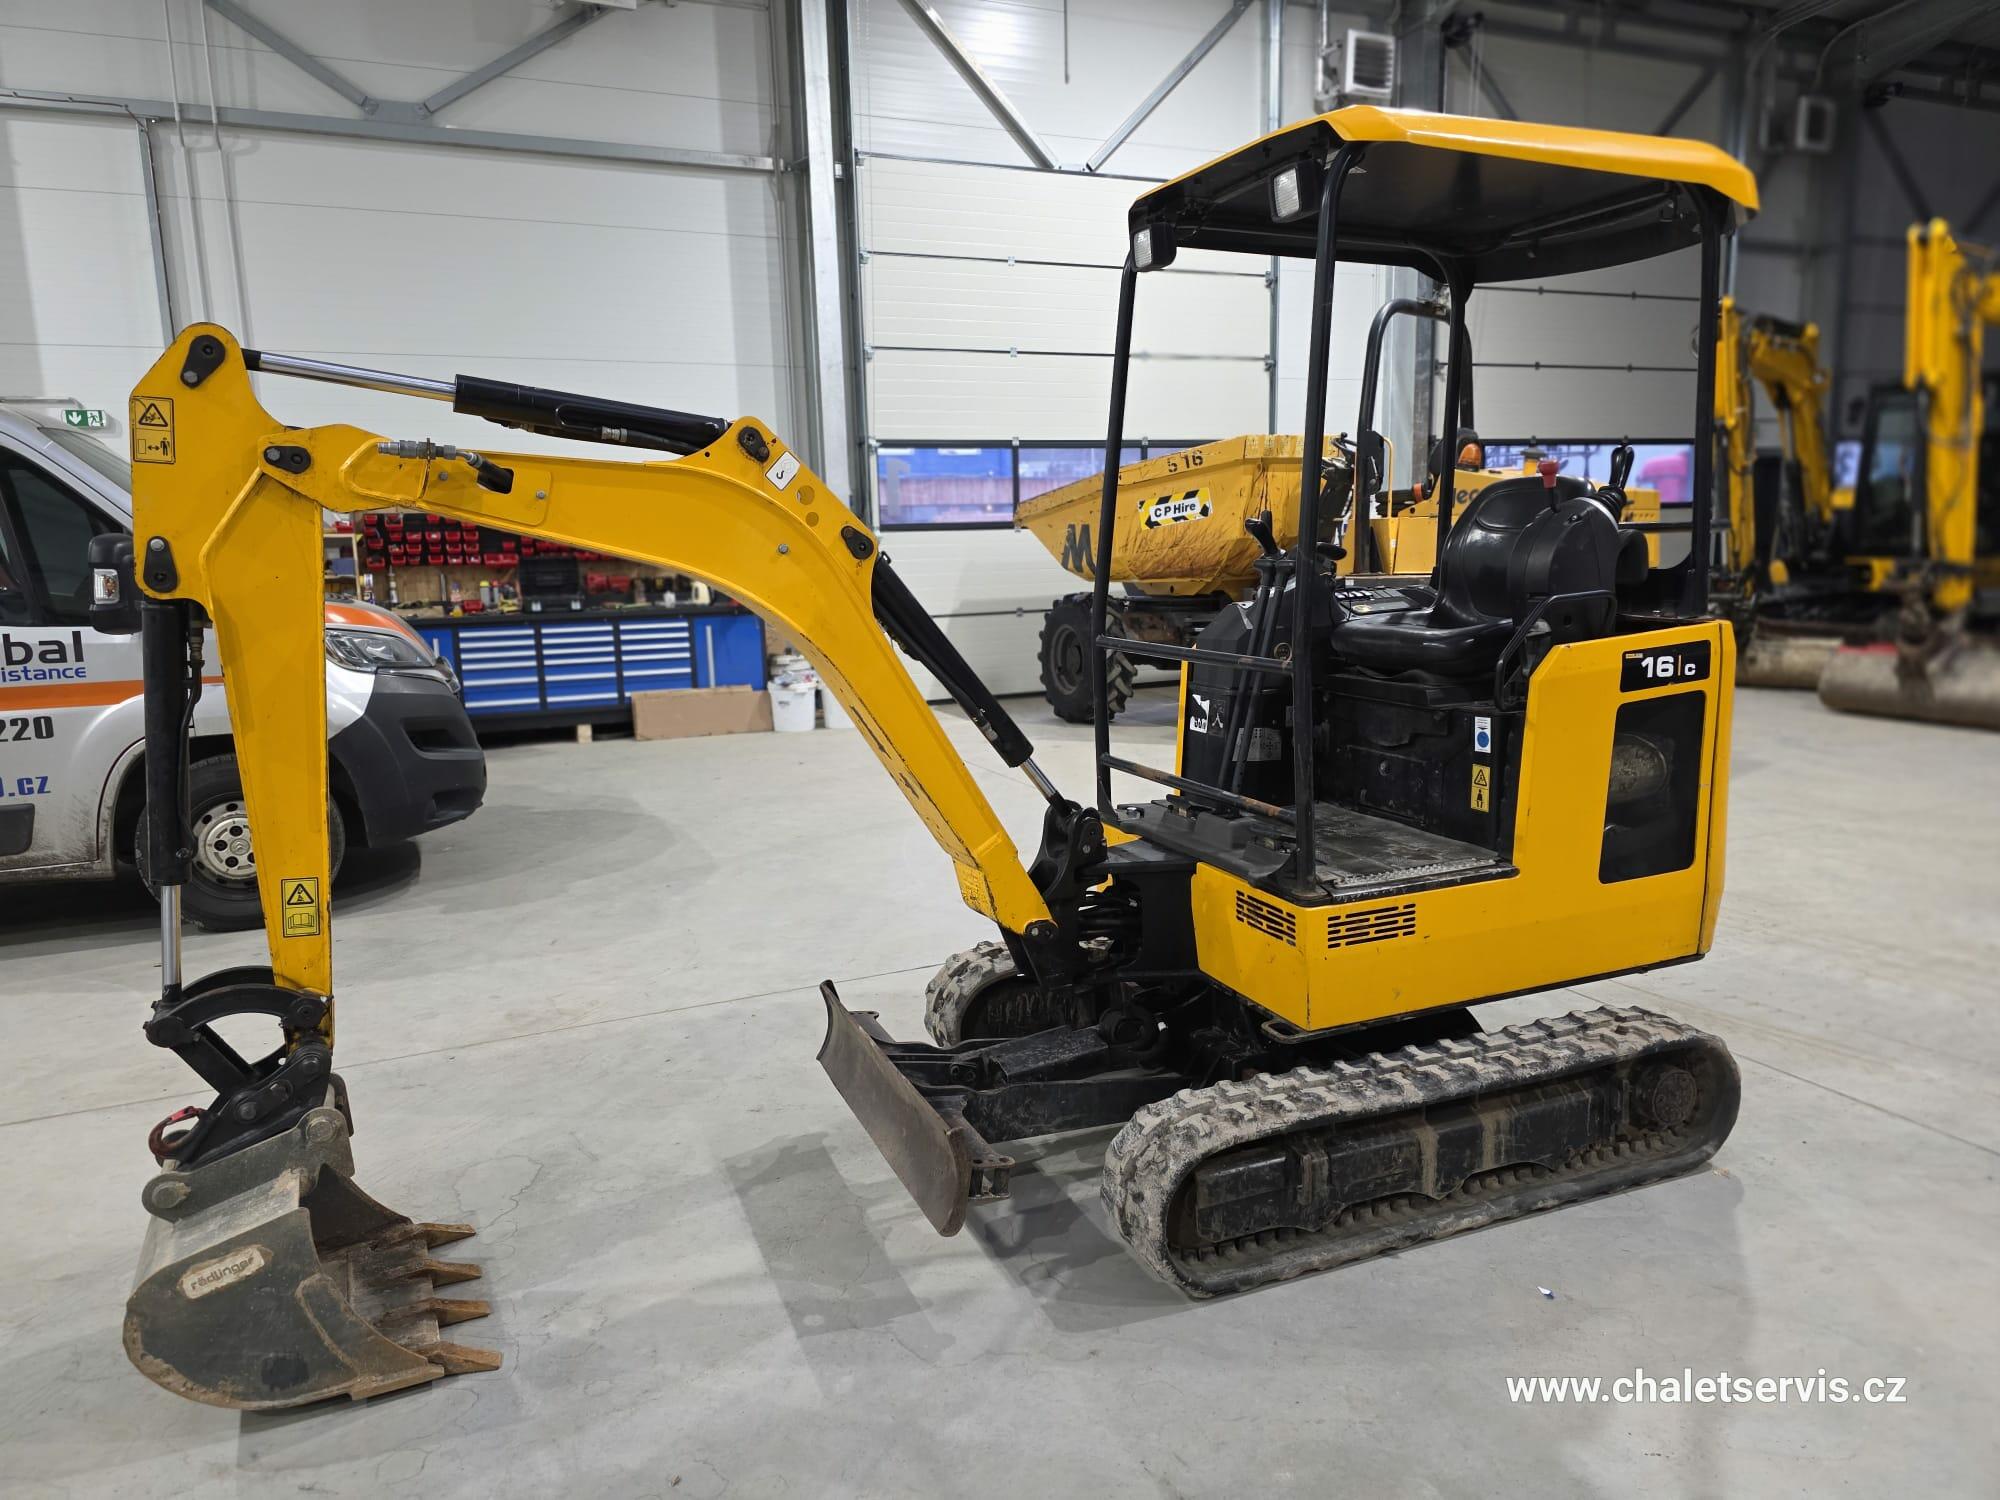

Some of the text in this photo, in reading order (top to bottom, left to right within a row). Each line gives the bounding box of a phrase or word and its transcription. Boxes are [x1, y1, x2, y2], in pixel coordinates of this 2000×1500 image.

[1173, 502, 1196, 515] Hire
[2, 630, 84, 666] bal
[1, 667, 86, 682] istance
[1641, 655, 1674, 678] 16
[0, 776, 51, 798] .cz
